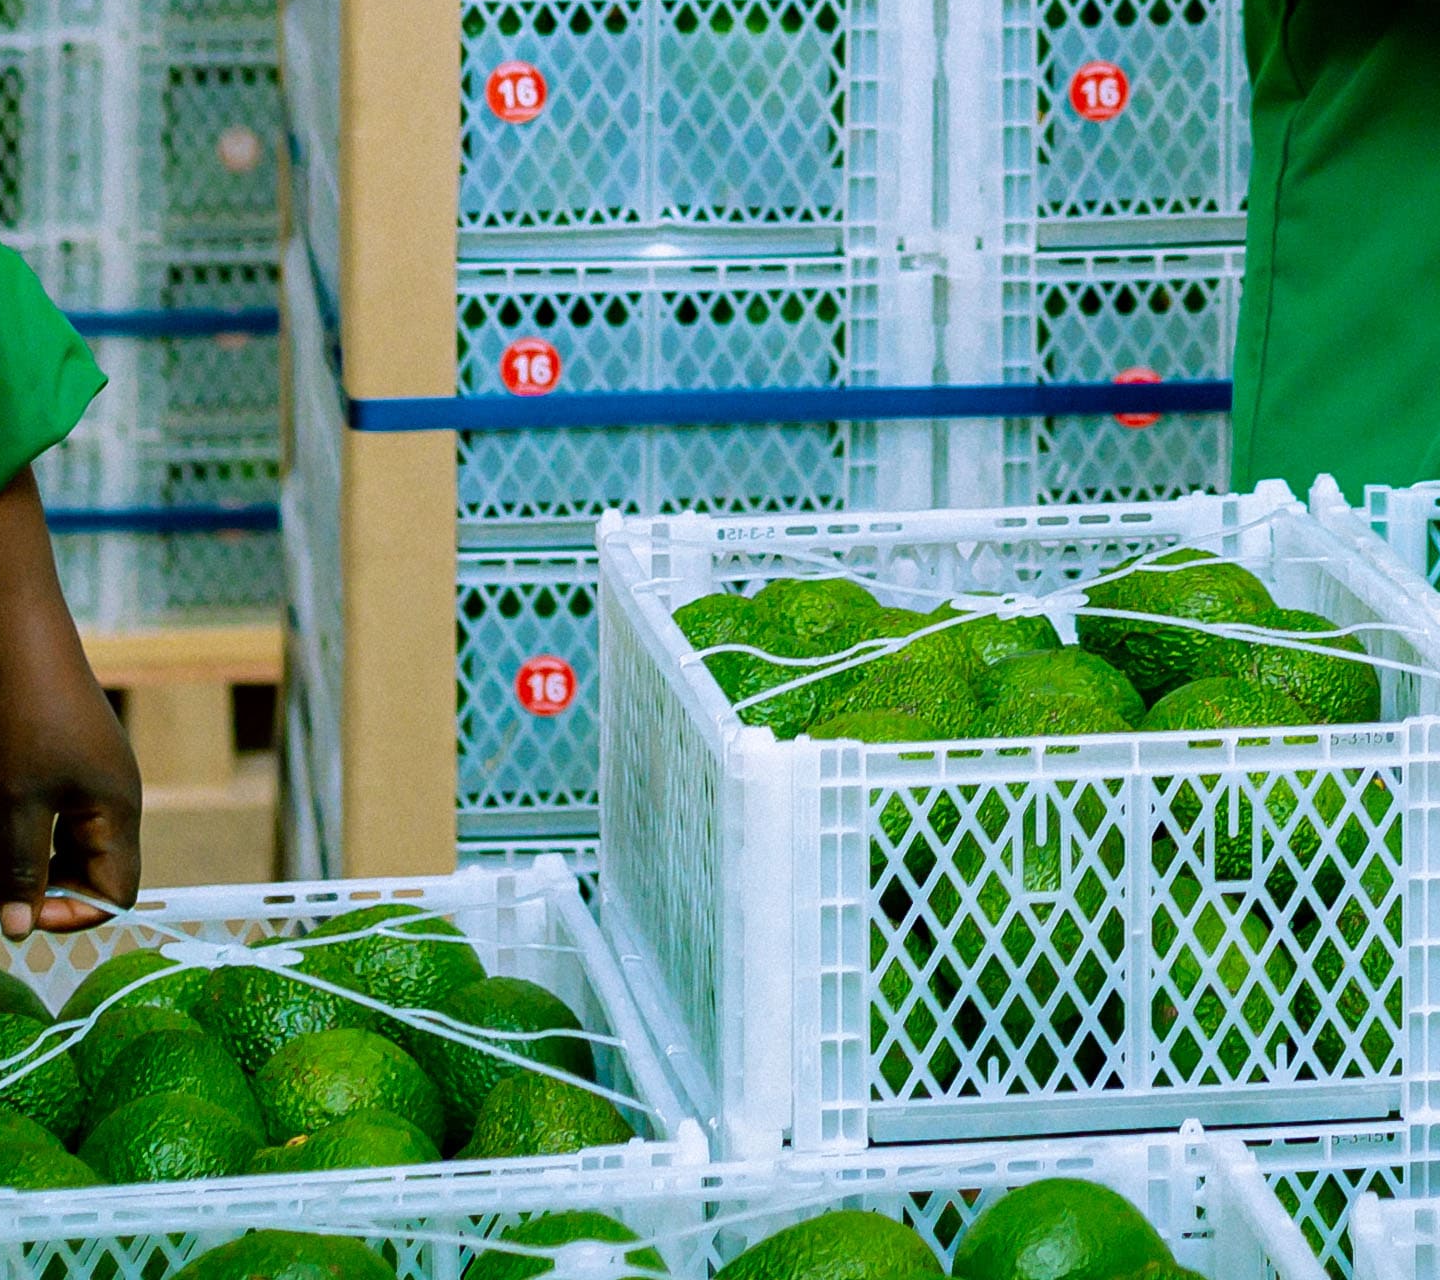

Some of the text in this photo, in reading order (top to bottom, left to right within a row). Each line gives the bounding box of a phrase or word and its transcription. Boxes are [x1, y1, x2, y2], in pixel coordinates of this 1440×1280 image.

[497, 76, 538, 109] 16
[1080, 78, 1120, 108] 16
[513, 354, 553, 385] 16
[527, 672, 567, 703] 16
